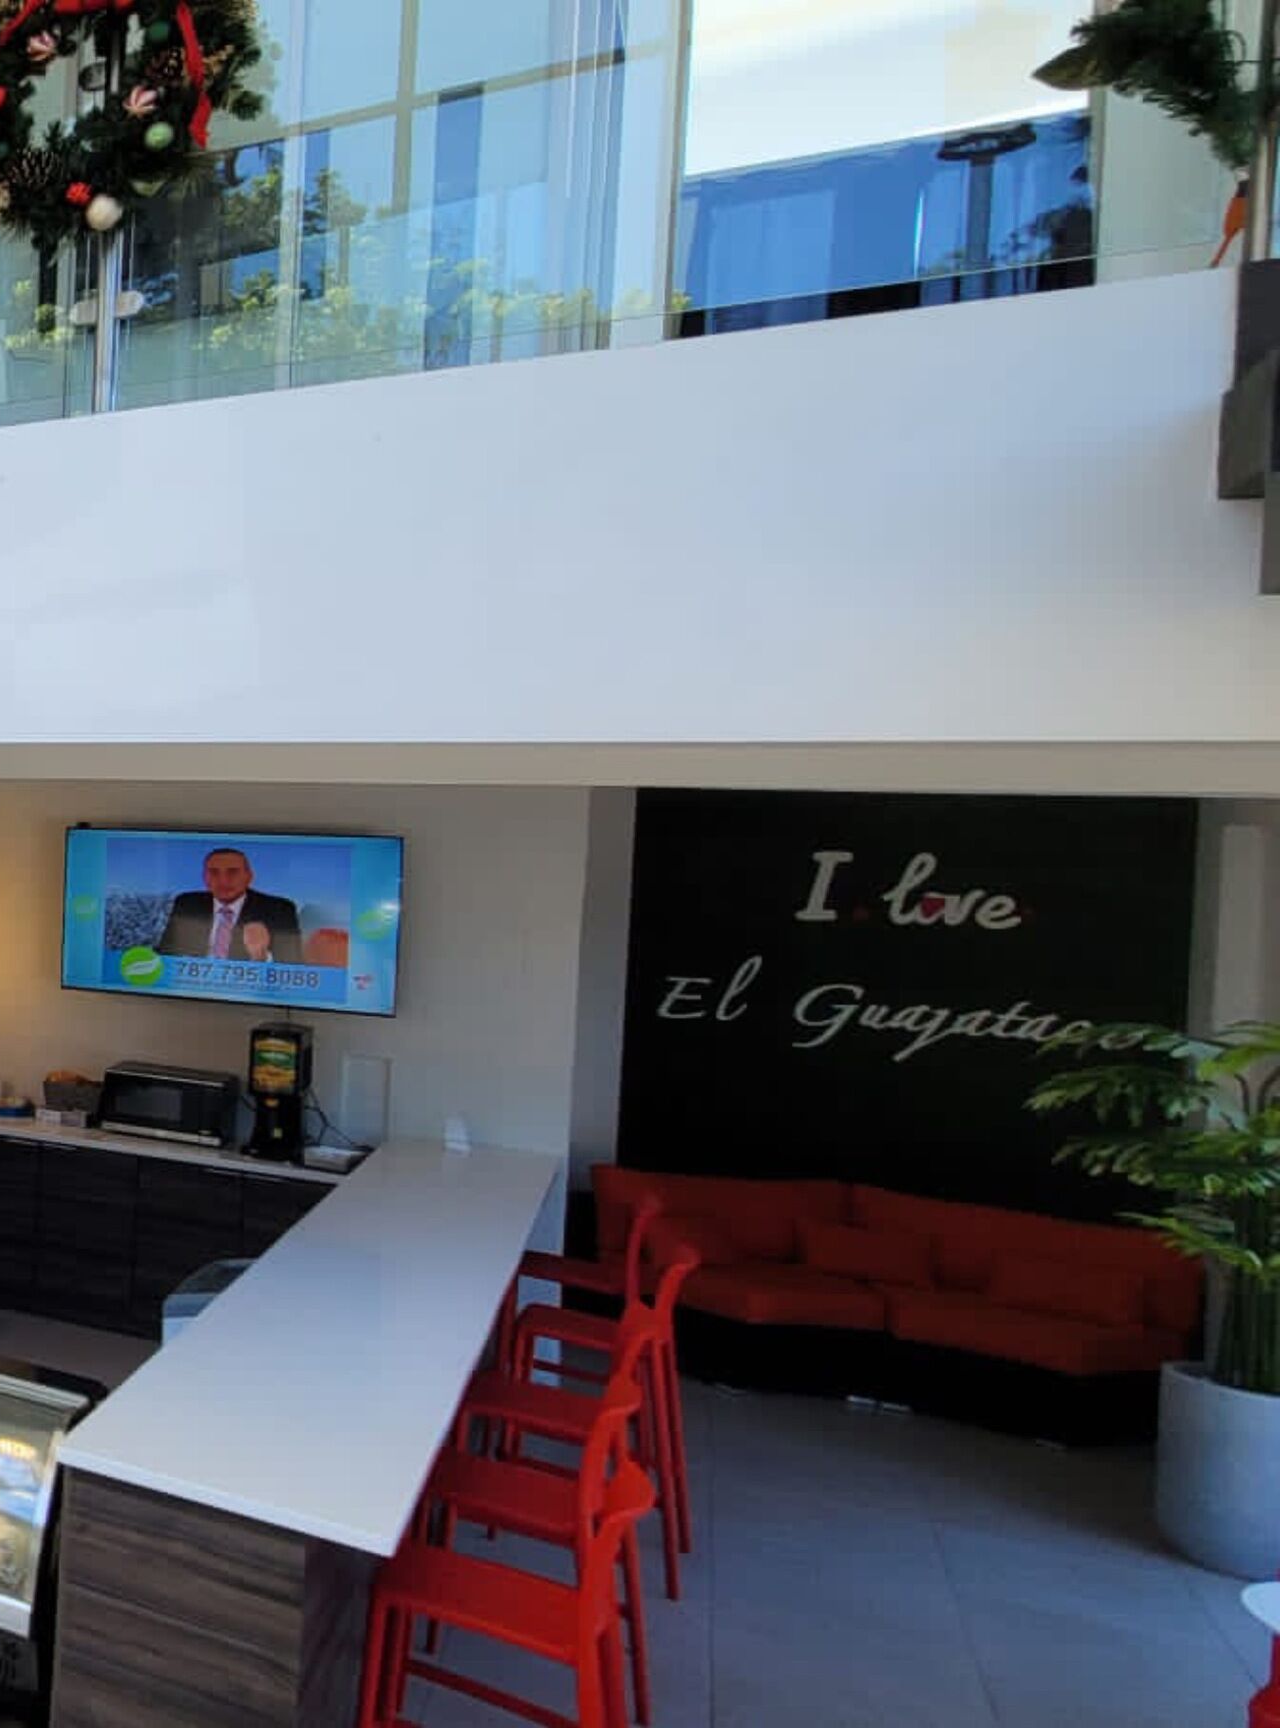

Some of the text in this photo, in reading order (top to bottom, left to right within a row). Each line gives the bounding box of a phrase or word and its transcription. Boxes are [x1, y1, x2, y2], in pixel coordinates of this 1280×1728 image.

[794, 850, 1022, 930] I love
[657, 956, 763, 1021] El
